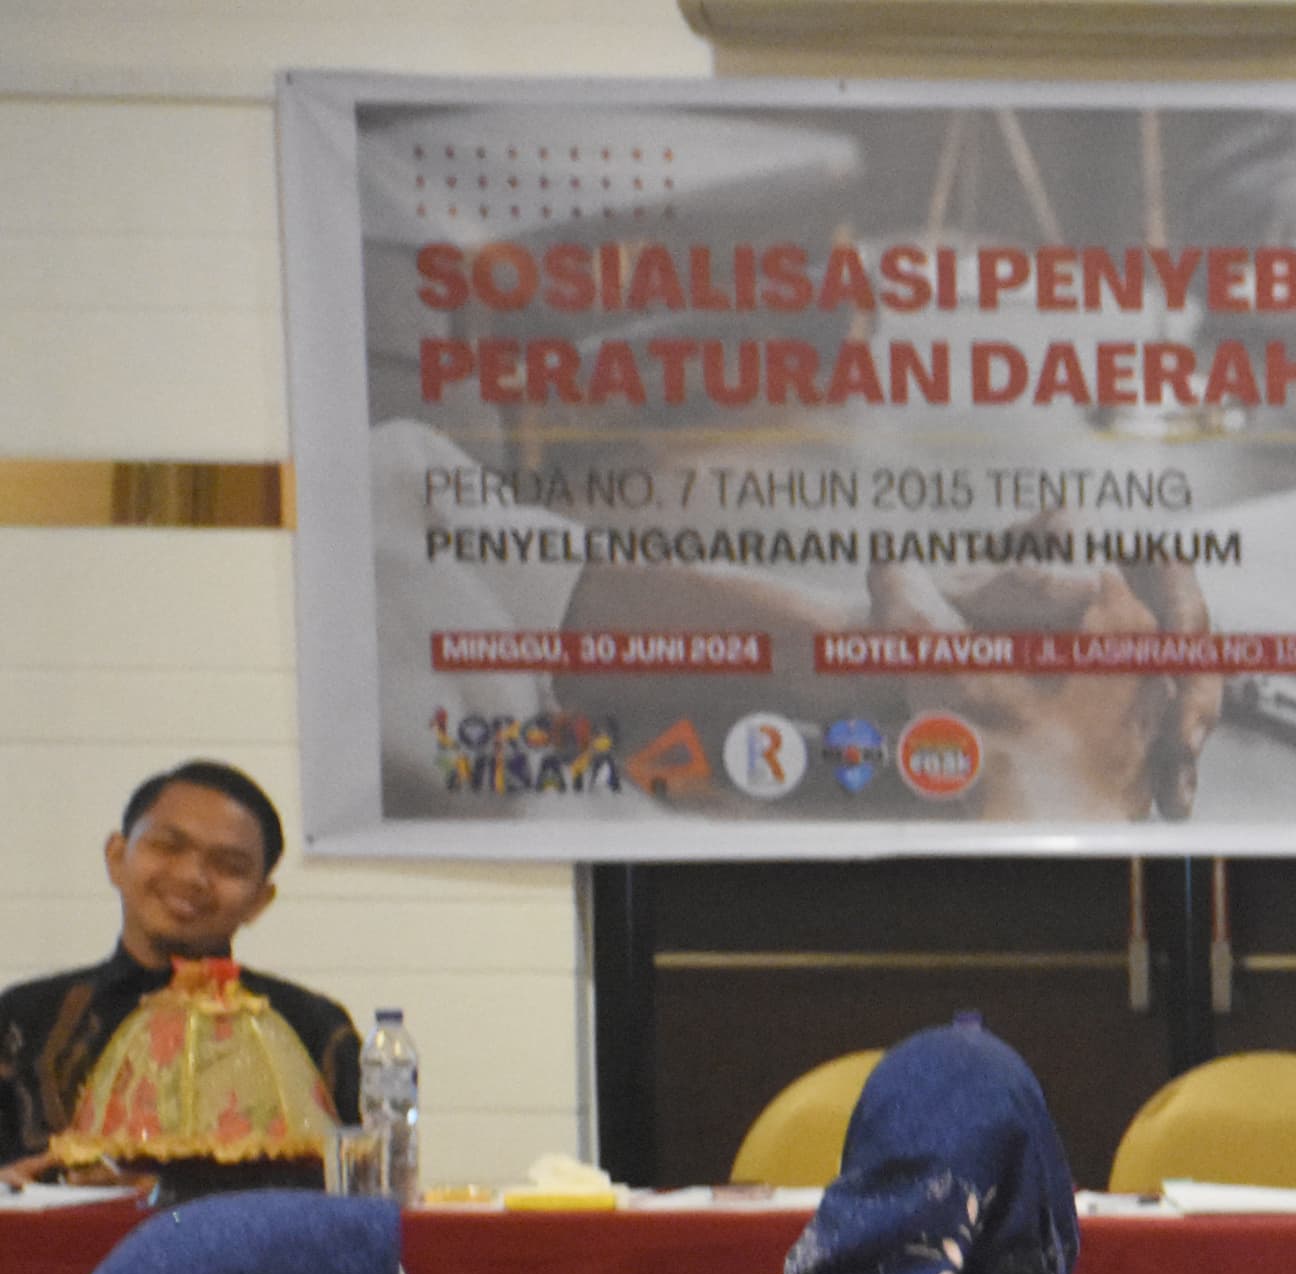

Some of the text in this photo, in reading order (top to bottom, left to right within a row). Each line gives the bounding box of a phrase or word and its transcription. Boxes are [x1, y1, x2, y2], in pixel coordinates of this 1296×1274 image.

[414, 241, 956, 313] SOSIALISASI
[418, 338, 950, 406] PERATURAN
[425, 468, 574, 506] PERDA
[680, 468, 698, 506] 7
[709, 468, 858, 507] TAHUN
[872, 468, 973, 509] 2015
[987, 468, 1193, 511] TENTANG
[426, 527, 1242, 566] PENYELENGGARAAN BANTUAN HUKUM
[579, 635, 616, 663] 30
[622, 635, 685, 664] JUNI
[690, 635, 760, 664] 2024
[824, 637, 908, 664] HOTEL
[917, 637, 1012, 664] FAVOR
